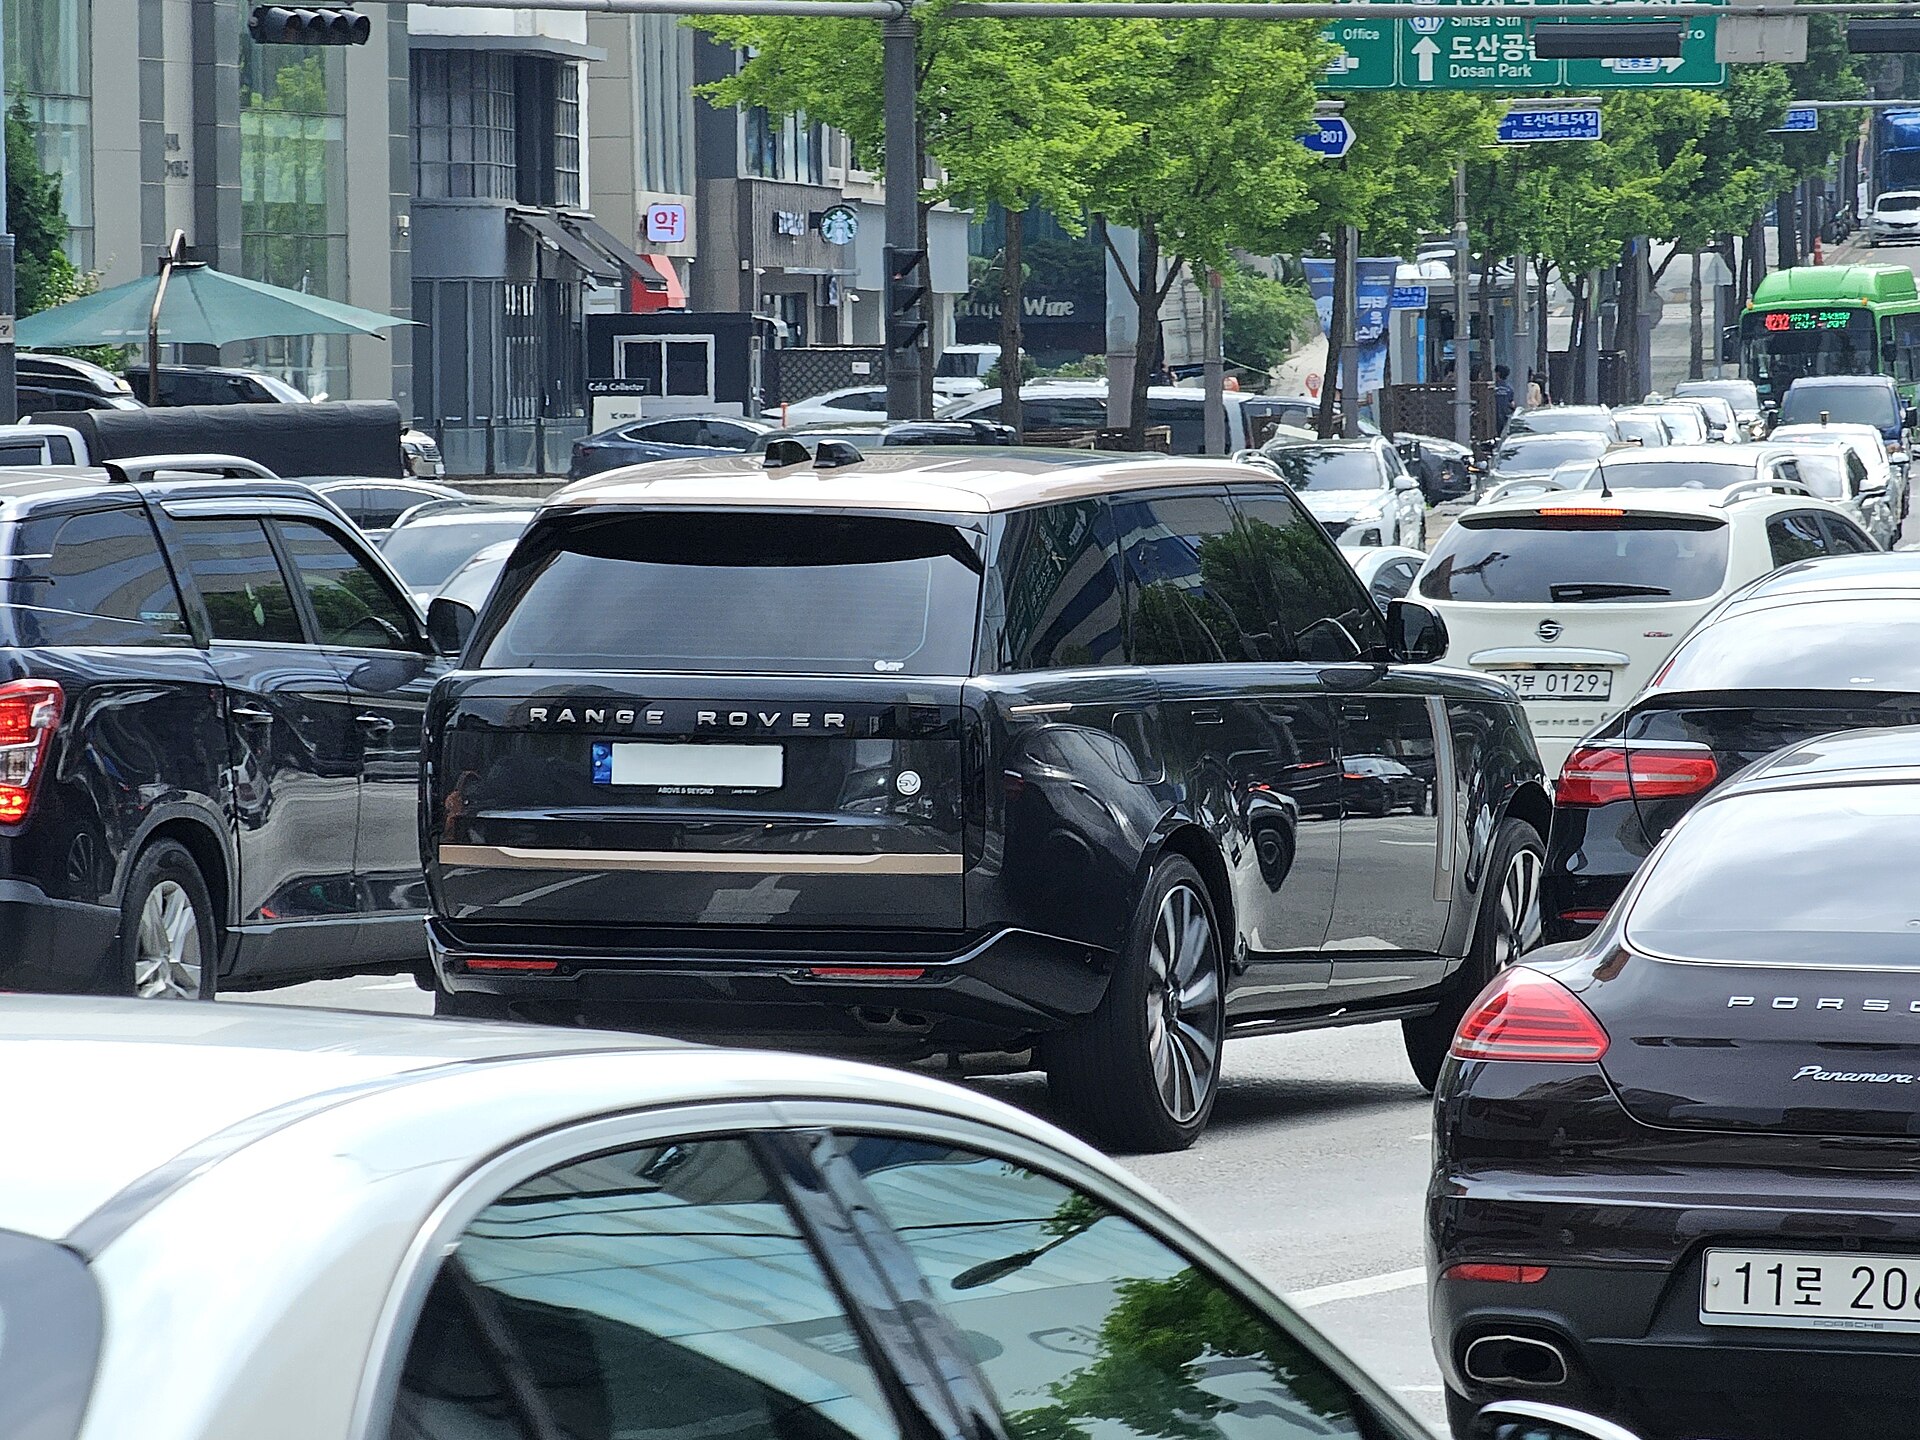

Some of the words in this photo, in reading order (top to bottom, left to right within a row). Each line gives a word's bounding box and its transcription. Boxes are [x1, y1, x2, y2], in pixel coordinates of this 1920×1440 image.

[1342, 27, 1380, 40] Office
[1449, 64, 1495, 78] Dosan
[1498, 63, 1532, 78] Park
[1320, 130, 1343, 144] 801
[654, 211, 679, 236] 약
[1545, 673, 1600, 693] 0129
[529, 707, 665, 726] RANGE
[697, 710, 845, 728] ROVER
[1792, 1065, 1914, 1084] Panamera
[1734, 1261, 1822, 1306] 11로
[1850, 1265, 1920, 1311] 20
[1813, 1320, 1885, 1330] PORSCHE
